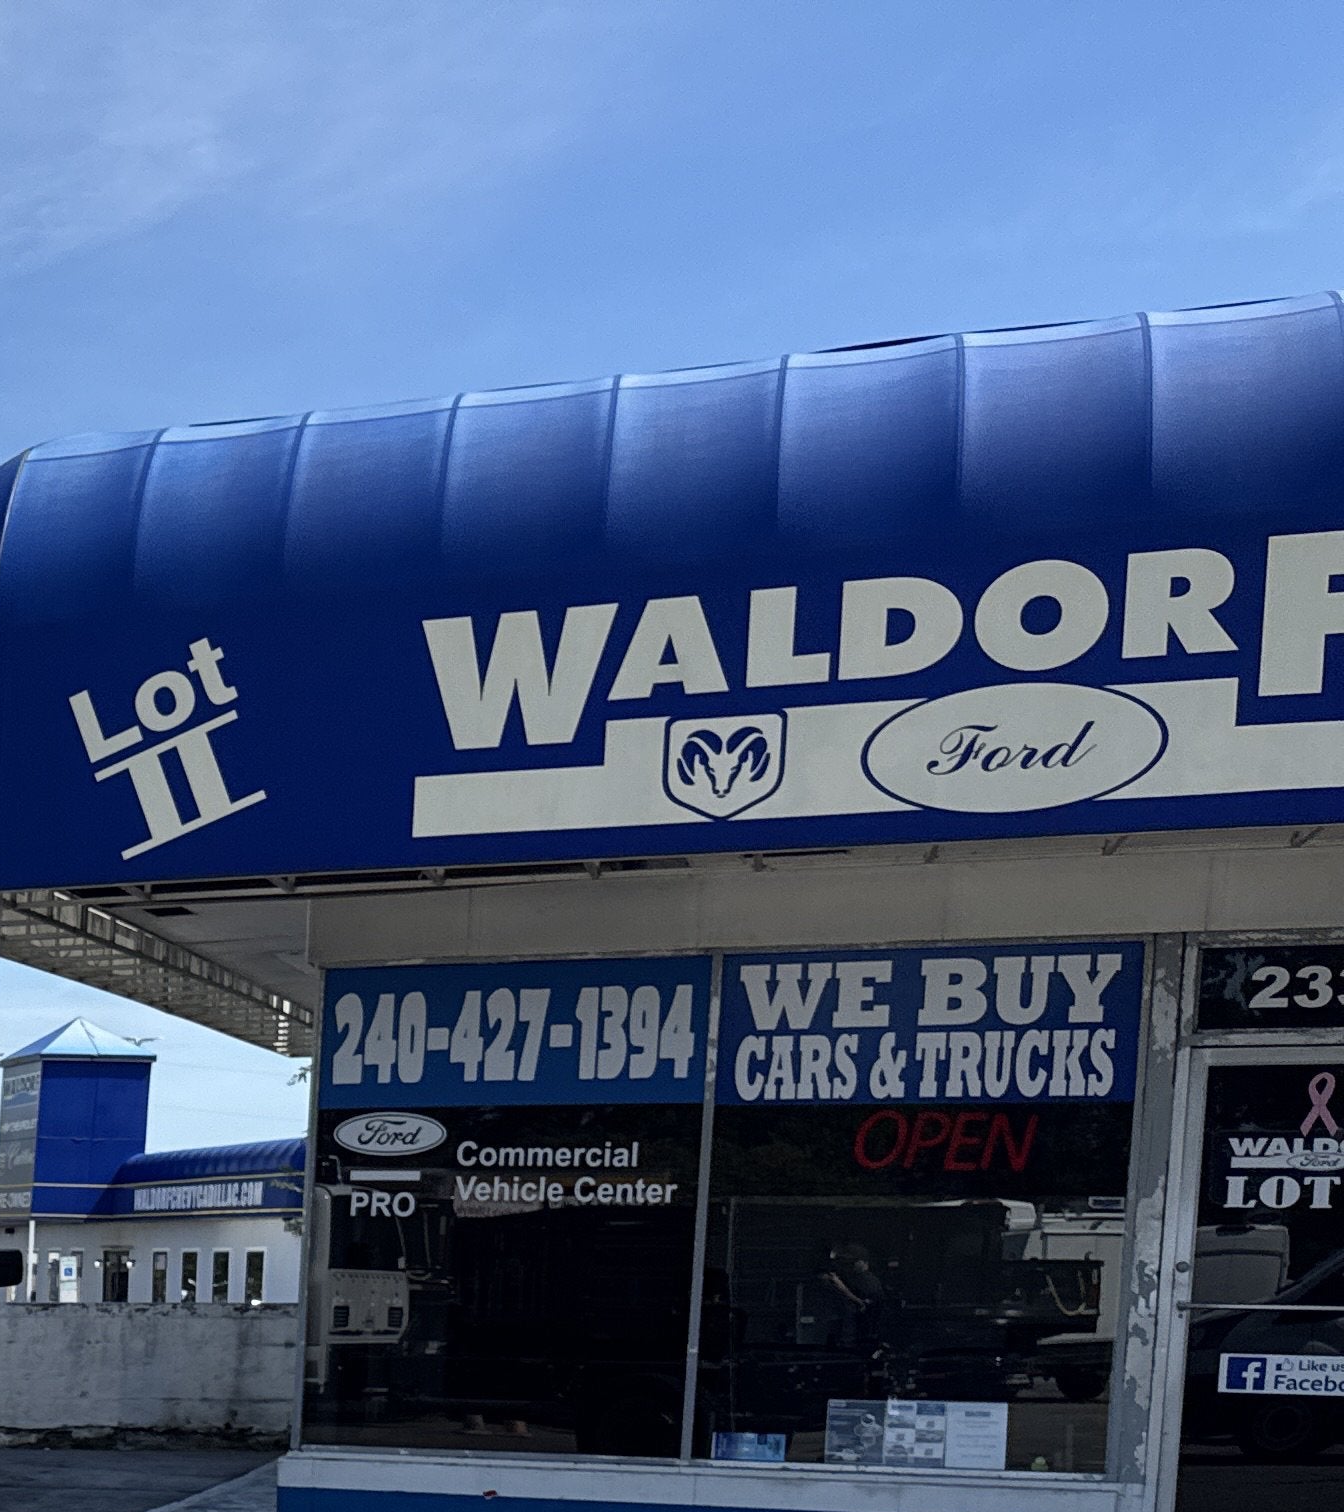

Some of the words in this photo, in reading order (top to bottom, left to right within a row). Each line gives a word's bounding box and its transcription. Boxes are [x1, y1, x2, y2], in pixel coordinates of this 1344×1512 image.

[68, 636, 239, 764] Lot
[925, 720, 1098, 777] Ford
[94, 709, 267, 861] II
[739, 960, 893, 1031] WE
[917, 953, 1123, 1027] BUY
[1248, 964, 1344, 1009] 23
[332, 984, 695, 1086] 240-427-1394
[734, 1033, 859, 1101] CARS
[869, 1031, 908, 1099] &
[915, 1028, 1116, 1099] TRUCKS
[357, 1118, 421, 1147] Ford
[456, 1140, 639, 1169] Commercial
[853, 1109, 1039, 1172] OPEN
[1299, 1154, 1341, 1168] Ford
[350, 1191, 416, 1218] PRO
[456, 1175, 565, 1203] Vehicle
[574, 1176, 678, 1204] Center
[1223, 1175, 1342, 1209] LOT
[1299, 1359, 1328, 1373] Like
